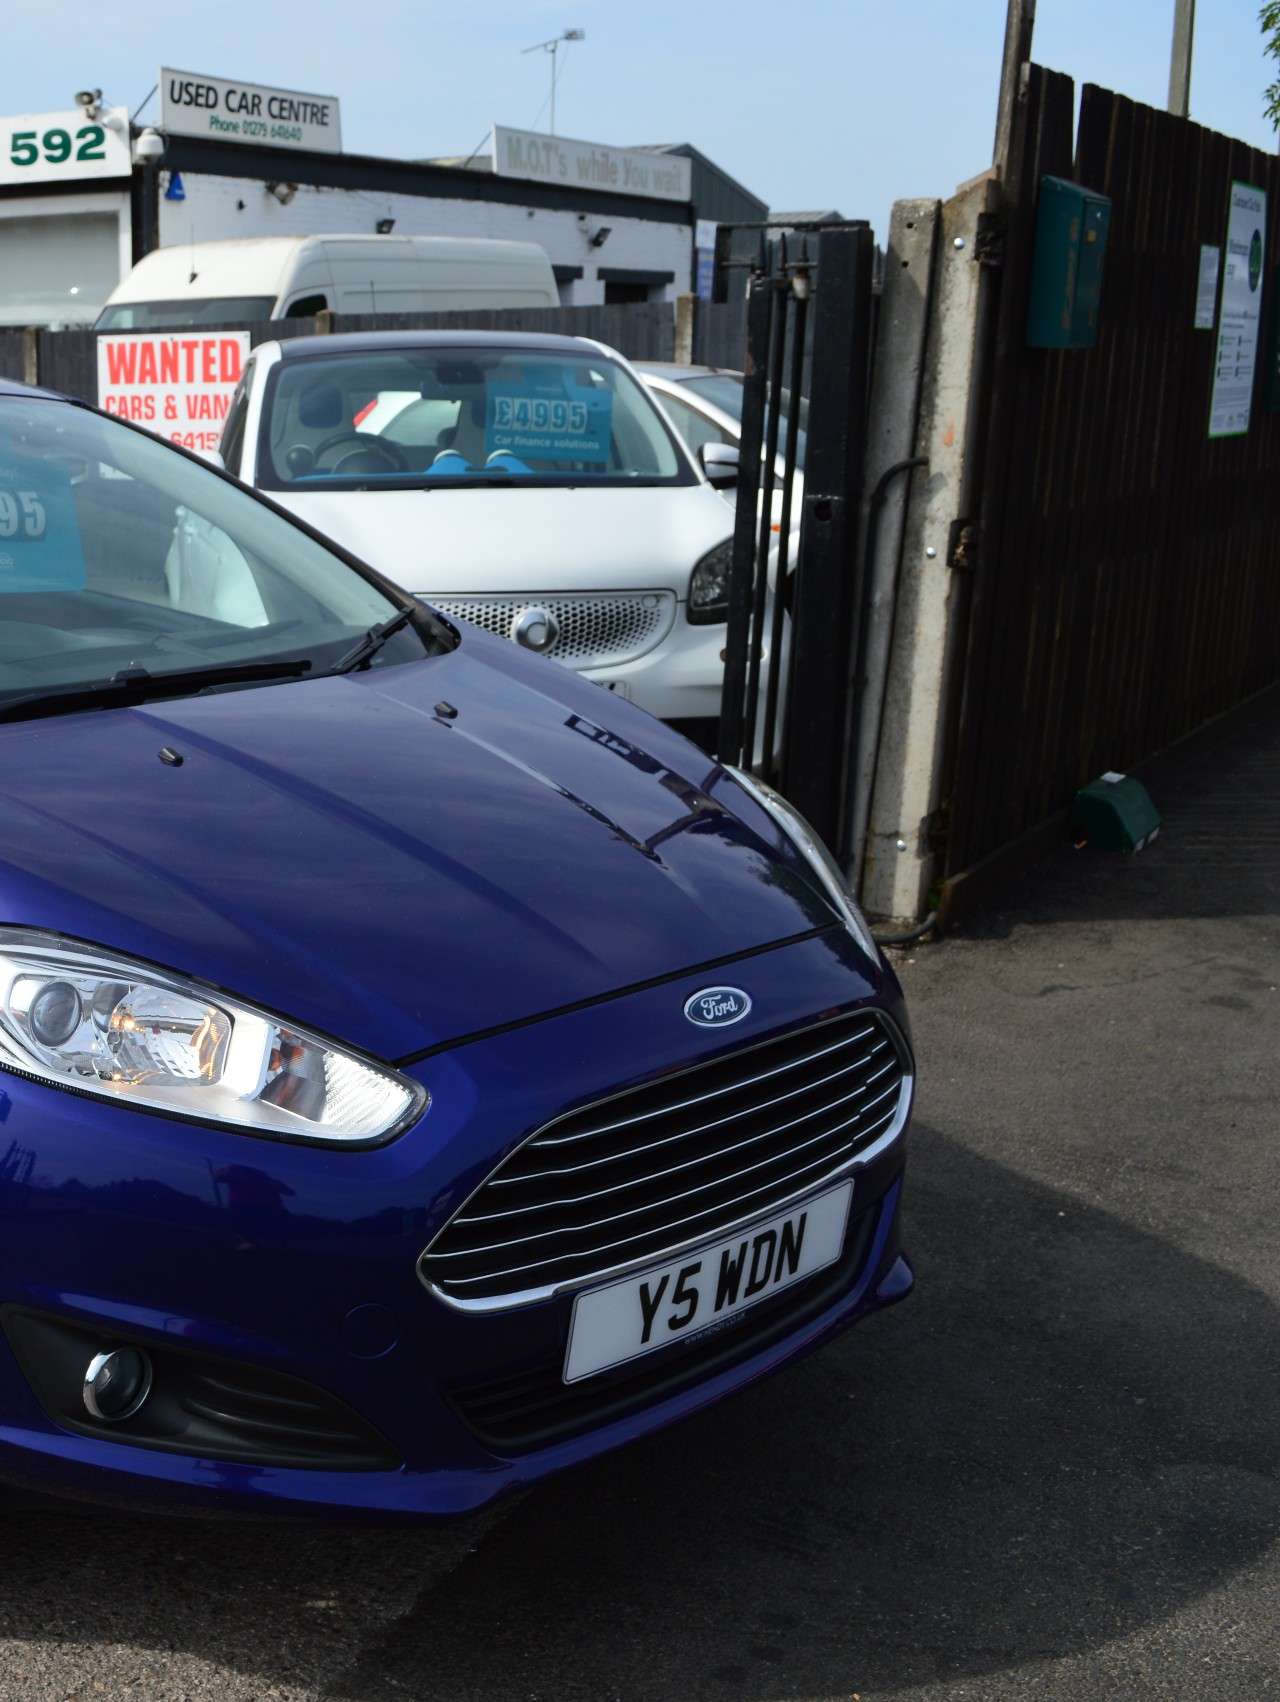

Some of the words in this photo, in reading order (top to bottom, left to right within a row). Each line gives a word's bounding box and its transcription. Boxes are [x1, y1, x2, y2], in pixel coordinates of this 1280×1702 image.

[170, 79, 218, 109] USED
[224, 89, 262, 116] CAR
[268, 97, 329, 126] CENTRE
[209, 115, 240, 134] Phone
[242, 120, 267, 137] 01279
[10, 124, 106, 166] 592
[577, 149, 617, 183] while
[652, 164, 682, 193] wait
[106, 339, 242, 385] WANTED
[105, 394, 156, 420] CARS
[164, 394, 177, 420] &
[495, 398, 587, 432] £4995
[170, 431, 224, 450] 6415
[494, 434, 512, 445] Car
[514, 436, 551, 447] finance
[554, 439, 600, 450] solutions
[700, 994, 738, 1019] Ford
[639, 1261, 702, 1344] Y5
[714, 1212, 807, 1312] WDN
